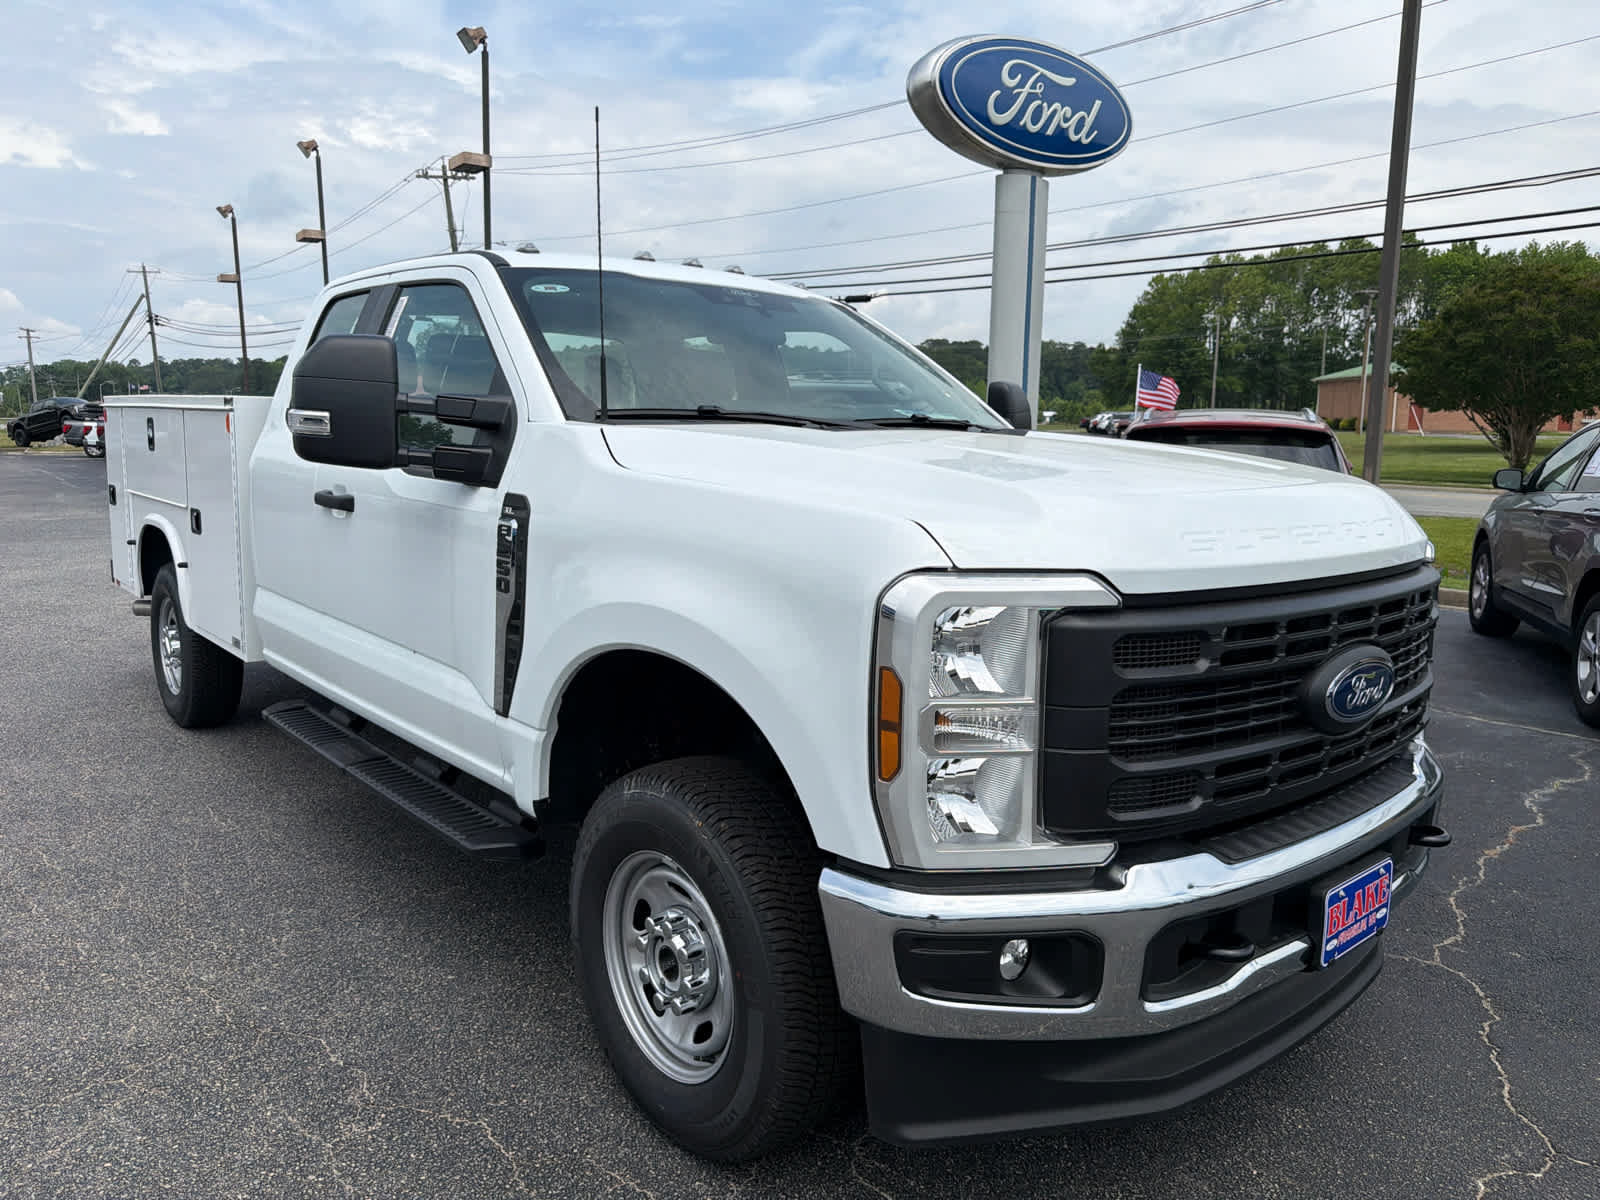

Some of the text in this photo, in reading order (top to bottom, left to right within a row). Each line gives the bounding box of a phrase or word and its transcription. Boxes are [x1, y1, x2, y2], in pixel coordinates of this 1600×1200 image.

[987, 59, 1102, 144] Ford
[1346, 671, 1384, 709] Ford
[1328, 874, 1389, 937] BLAKE
